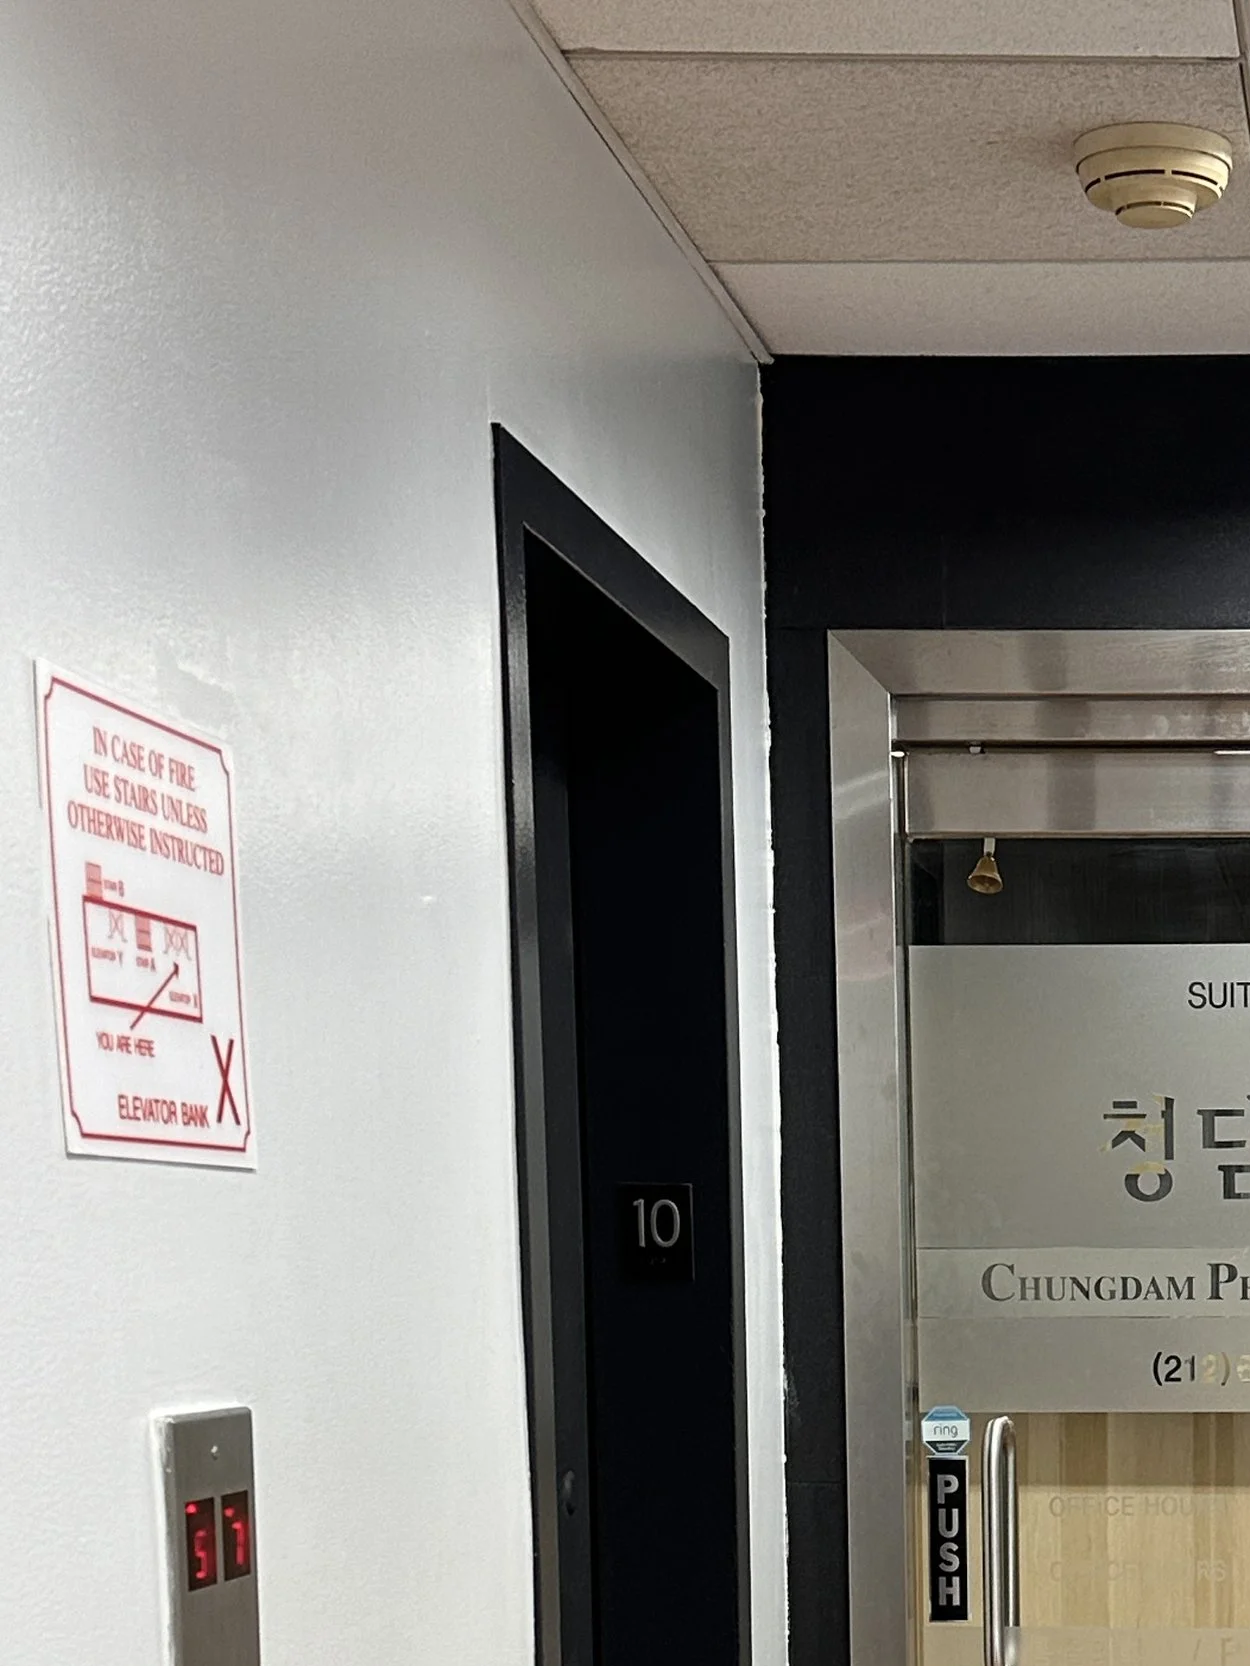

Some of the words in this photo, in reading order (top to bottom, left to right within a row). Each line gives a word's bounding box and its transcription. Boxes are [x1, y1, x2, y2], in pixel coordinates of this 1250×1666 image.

[92, 726, 107, 757] IN
[111, 734, 146, 772] CASE
[148, 749, 165, 779] OF
[168, 757, 196, 792] FIRE
[83, 763, 110, 799] USE
[114, 775, 158, 816] STAIRS
[161, 792, 208, 834] UNLESS
[67, 800, 146, 851] OTHERWISE
[149, 827, 225, 877] INSTRUCTED
[96, 1030, 114, 1051] YOU
[116, 1033, 133, 1055] ARE
[134, 1037, 155, 1058] HERE
[118, 1094, 176, 1126] ELEVATOR
[181, 1102, 211, 1129] BANK
[211, 1035, 241, 1126] X
[632, 1198, 681, 1248] 10
[981, 1261, 1196, 1303] CHUNGDAM
[933, 1424, 958, 1439] ring
[1145, 1496, 1222, 1517] HOU
[936, 1473, 962, 1607] PUSH
